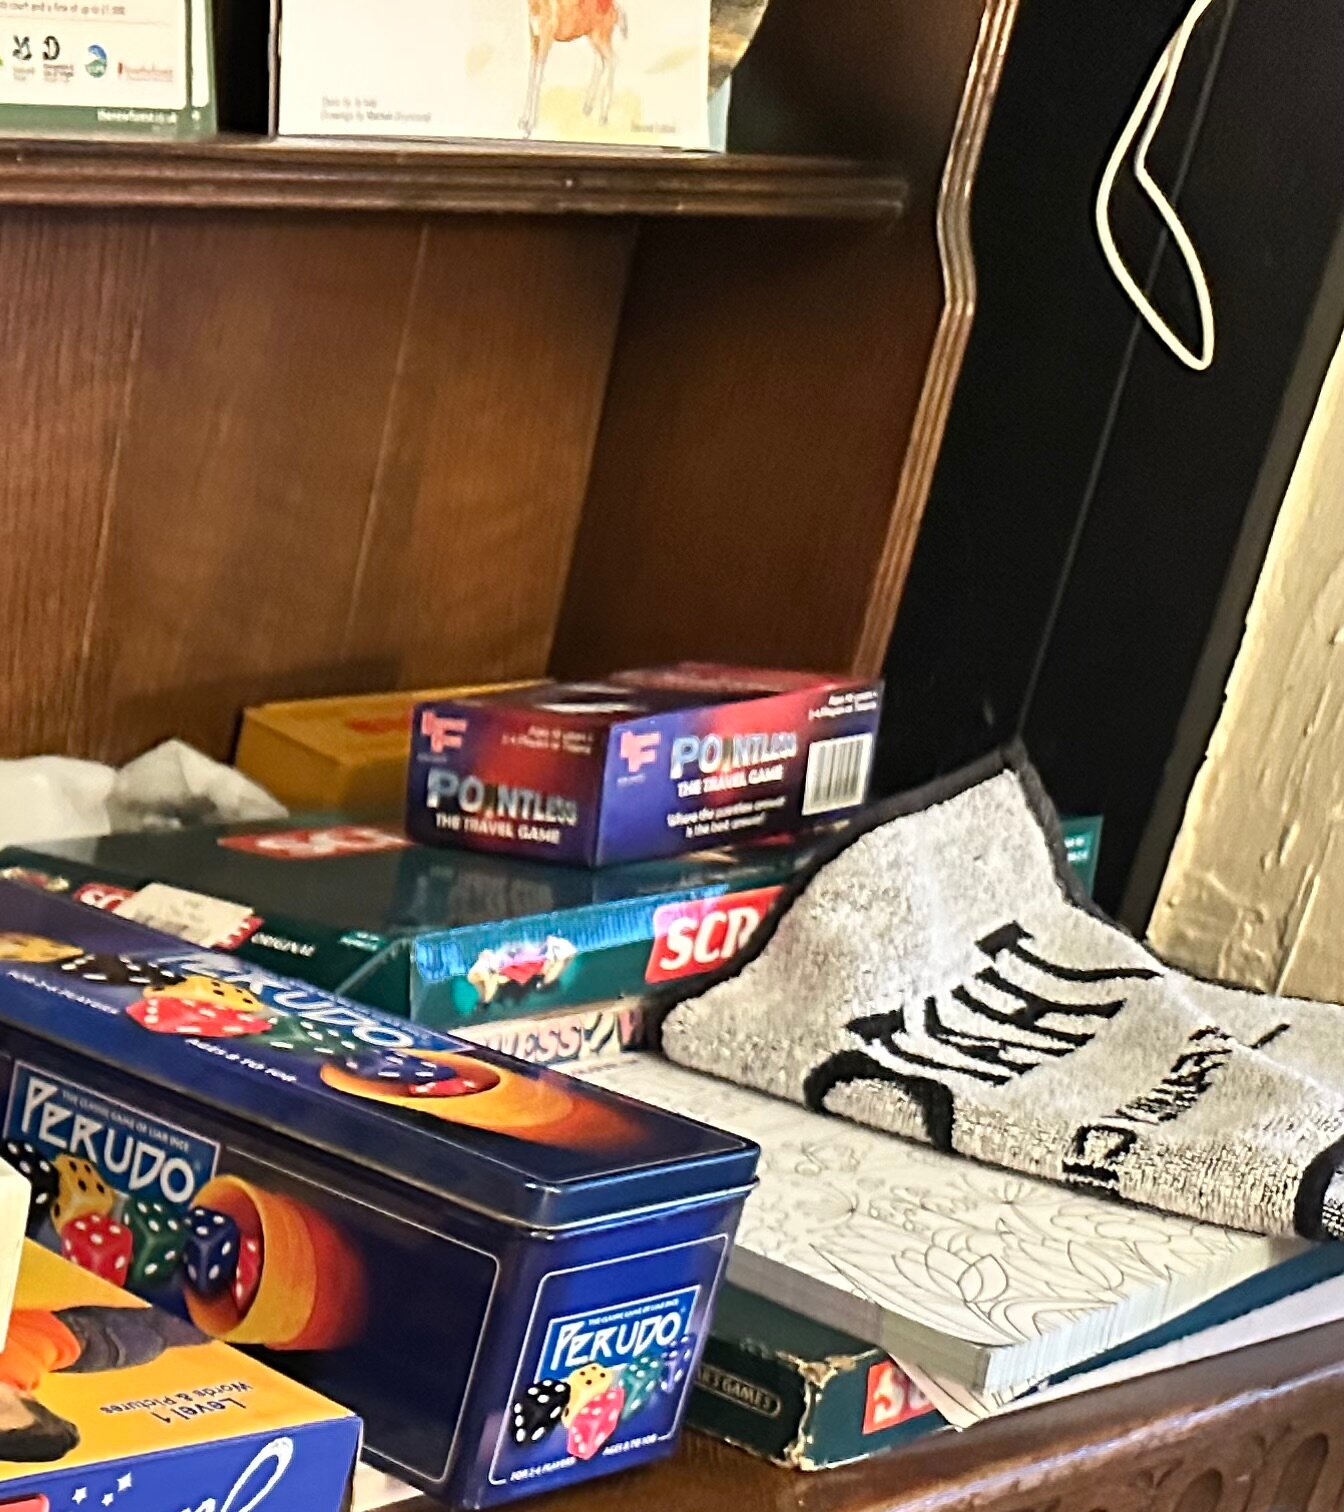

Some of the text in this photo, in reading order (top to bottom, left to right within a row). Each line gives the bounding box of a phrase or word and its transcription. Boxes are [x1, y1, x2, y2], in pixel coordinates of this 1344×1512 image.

[677, 764, 784, 797] THE TRAVEL GAME
[435, 813, 561, 845] THE TRAVEL GAME
[21, 1076, 195, 1204] PERUDO
[550, 1311, 681, 1371] PERUDO
[99, 1380, 253, 1416] Words & Pictures
[170, 1398, 247, 1421] Level
[721, 1374, 772, 1410] GAMES
